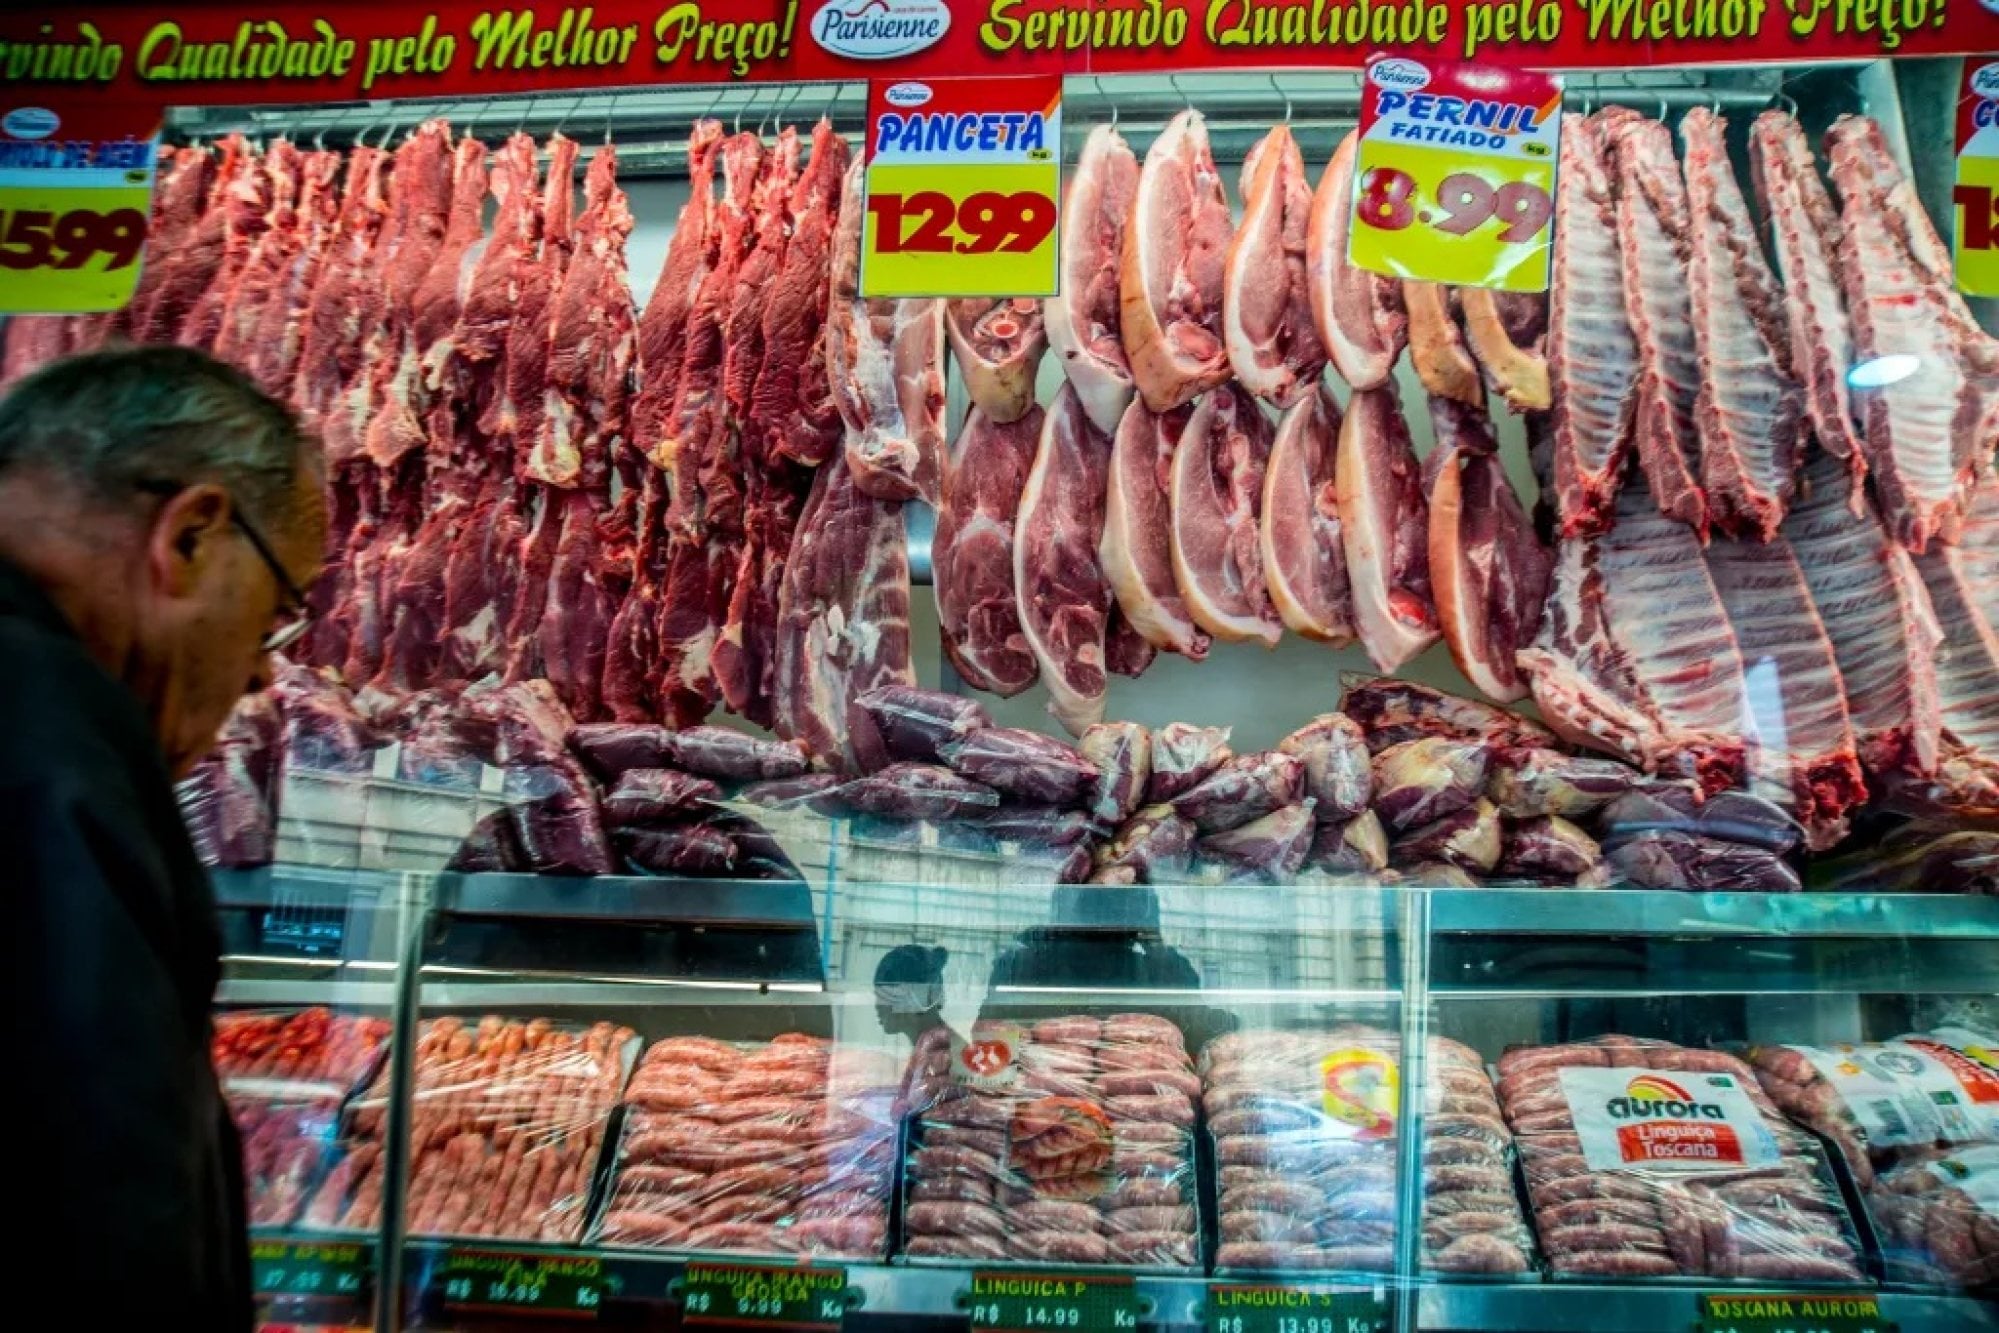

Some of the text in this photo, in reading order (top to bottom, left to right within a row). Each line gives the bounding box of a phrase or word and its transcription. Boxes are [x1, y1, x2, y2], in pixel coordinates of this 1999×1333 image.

[822, 9, 939, 41] Parisienne
[979, 0, 1946, 58] Servindo Qualidade pelo Melhor Preço!
[136, 18, 355, 80] Qualidade
[362, 15, 456, 89] pelo
[470, 7, 639, 69] Melhor
[655, 0, 798, 75] Preço!
[1378, 90, 1539, 133] PERNIL
[877, 112, 1044, 152] PANCETA
[1390, 122, 1506, 149] FATIADO
[1356, 166, 1554, 243] 8.99
[1606, 1096, 1726, 1119] aurora
[1641, 1141, 1719, 1158] Toscana
[975, 1279, 1067, 1297] LINGUICA
[974, 1304, 999, 1324] R$
